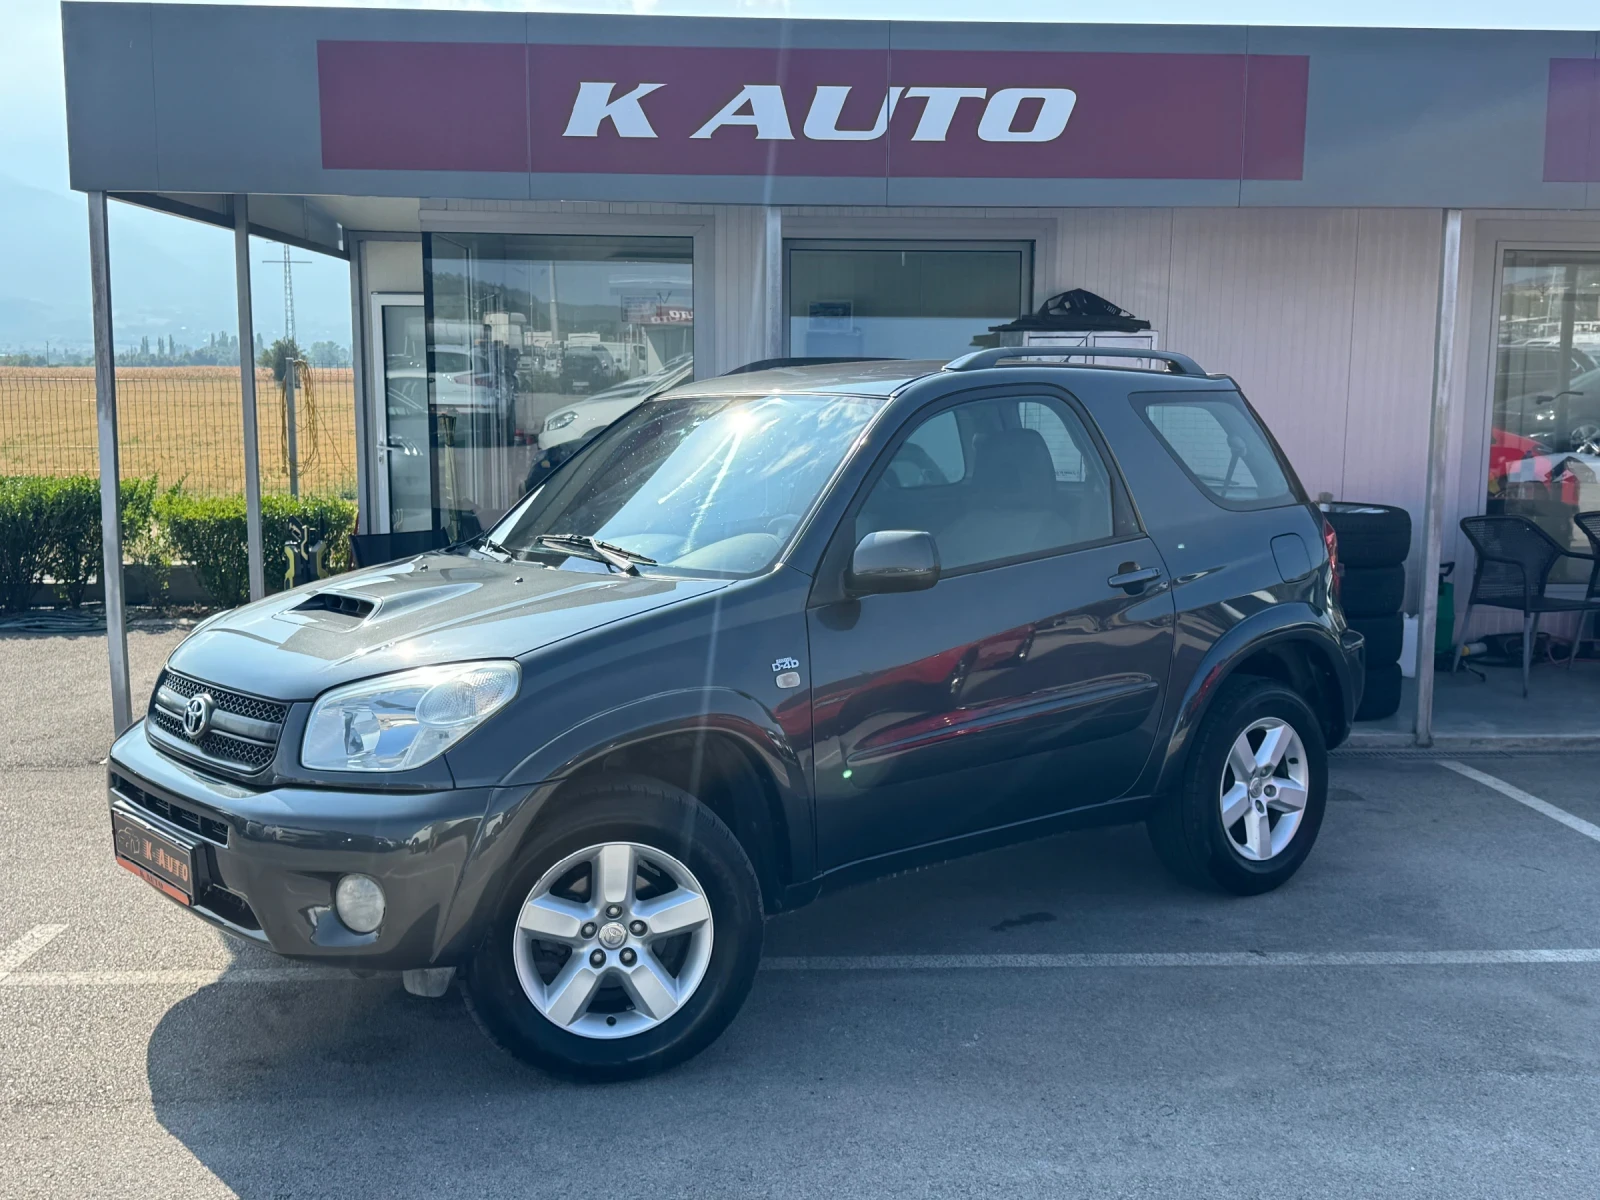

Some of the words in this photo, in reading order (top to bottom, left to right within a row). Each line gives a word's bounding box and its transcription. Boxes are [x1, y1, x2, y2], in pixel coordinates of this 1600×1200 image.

[562, 82, 667, 138] K
[689, 85, 1077, 142] AUTO
[772, 659, 799, 671] D-4D
